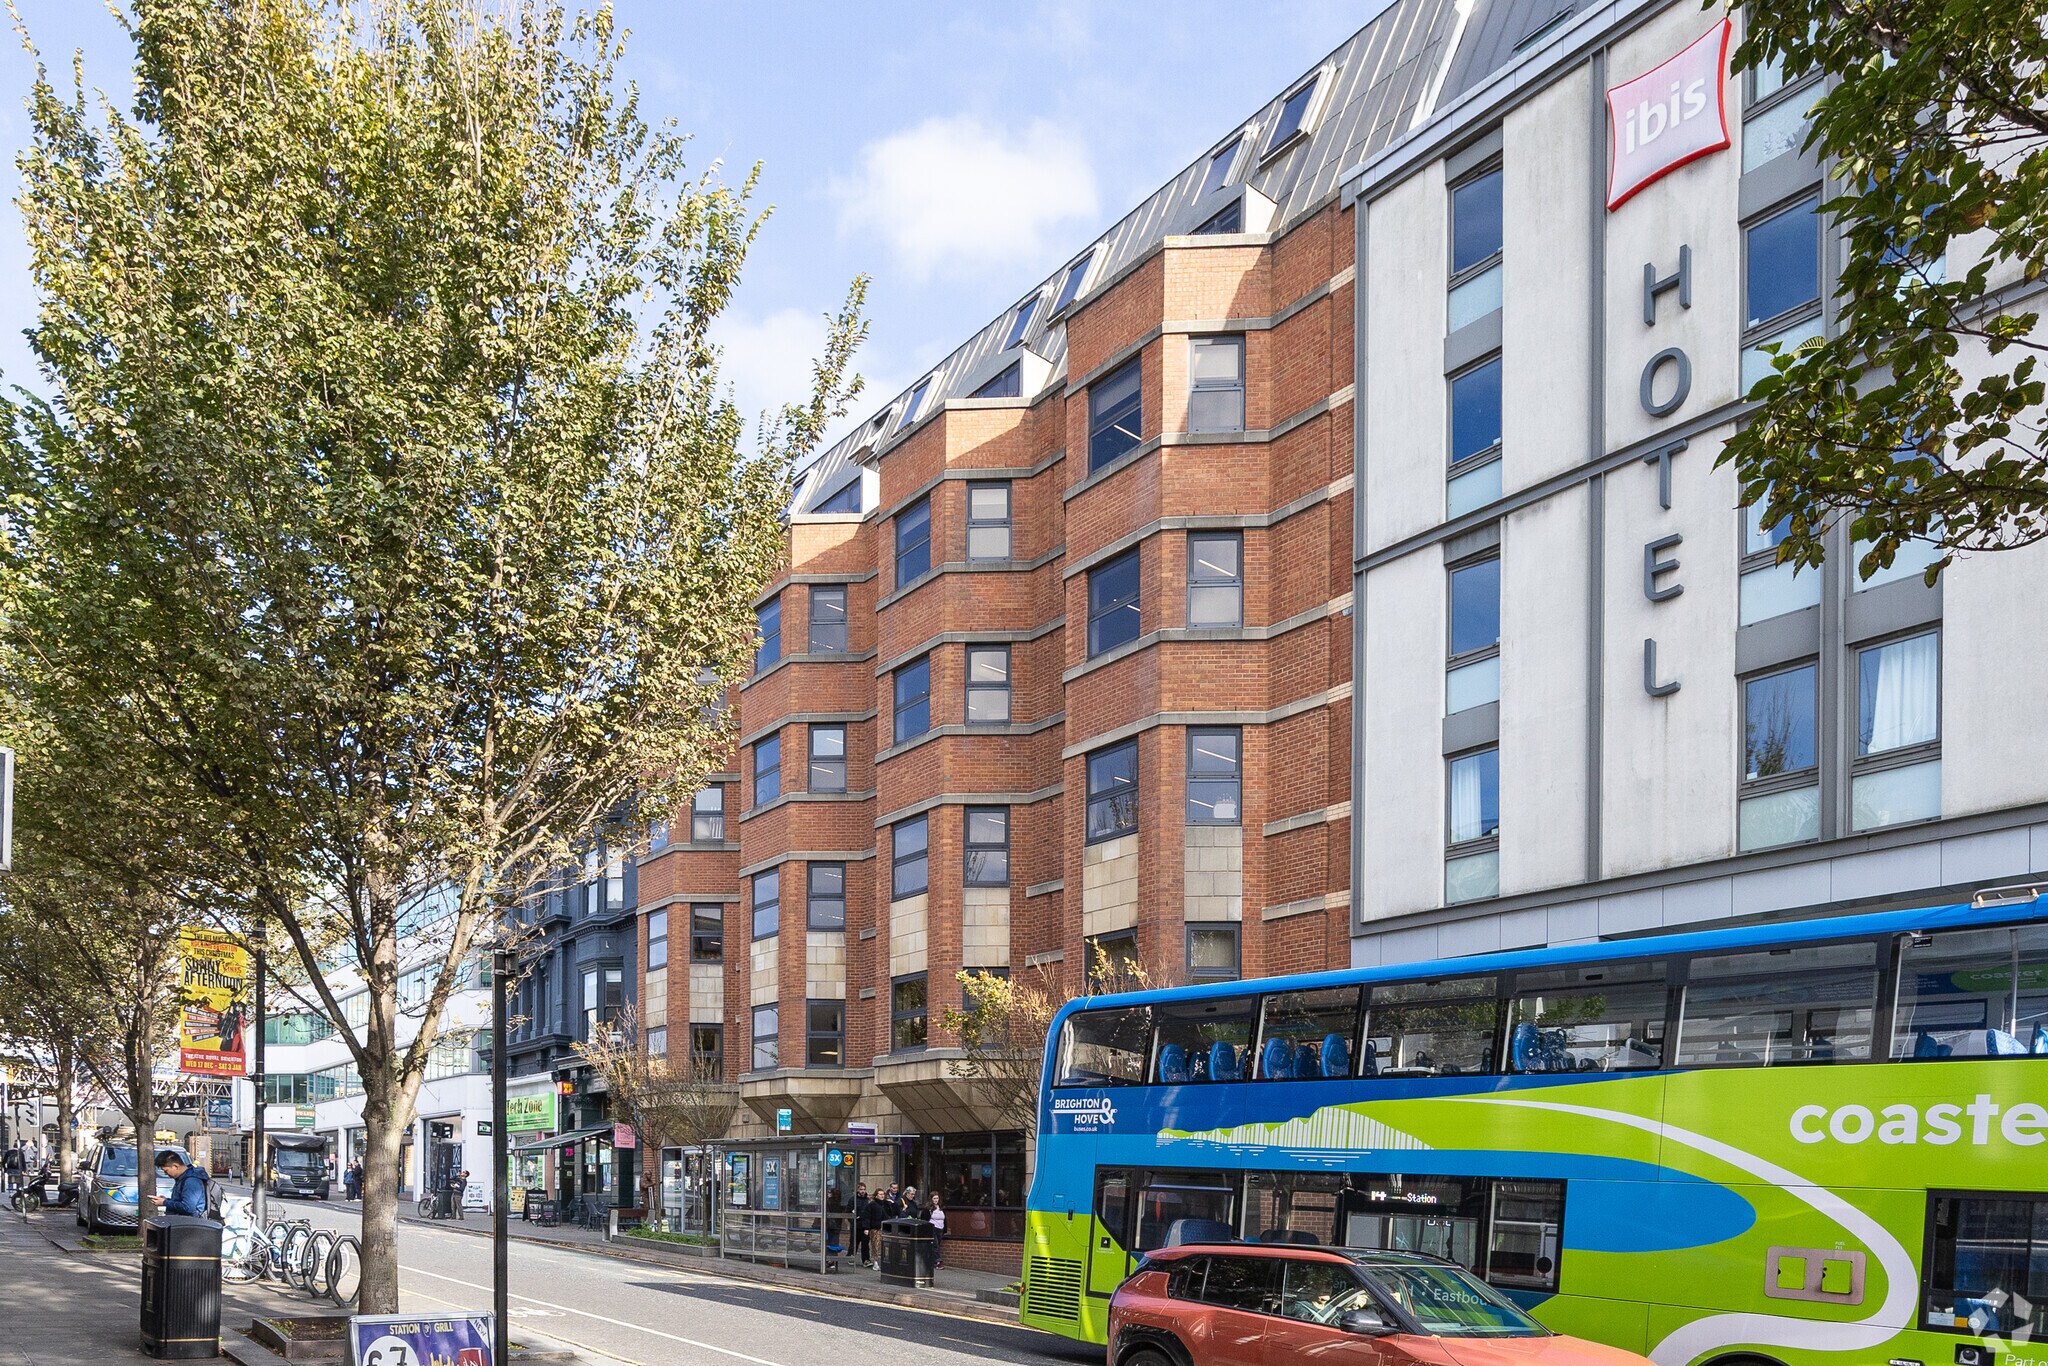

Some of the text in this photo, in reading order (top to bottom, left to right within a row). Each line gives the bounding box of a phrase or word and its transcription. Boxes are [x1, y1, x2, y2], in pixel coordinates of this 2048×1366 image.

[1625, 78, 1707, 155] ibis
[1639, 243, 1692, 699] HOTEL
[193, 947, 205, 957] THIS
[185, 957, 221, 975] SUNNY
[184, 971, 243, 989] AFTERNOON
[185, 1060, 197, 1068] WED
[204, 1061, 214, 1069] DEC
[218, 1062, 228, 1070] SAT
[523, 1097, 543, 1114] Zone
[1055, 1099, 1100, 1109] BRIGHTON
[1074, 1114, 1099, 1124] HOVE
[1789, 1093, 2048, 1146] coaste
[829, 1154, 840, 1162] 3X
[766, 1160, 776, 1173] 3X
[1407, 1192, 1437, 1204] Station
[1433, 1287, 1491, 1307] Eastbou
[389, 1323, 420, 1335] STATION
[433, 1322, 454, 1333] GRILL
[473, 1318, 488, 1337] NEW
[2005, 1354, 2035, 1366] Part
